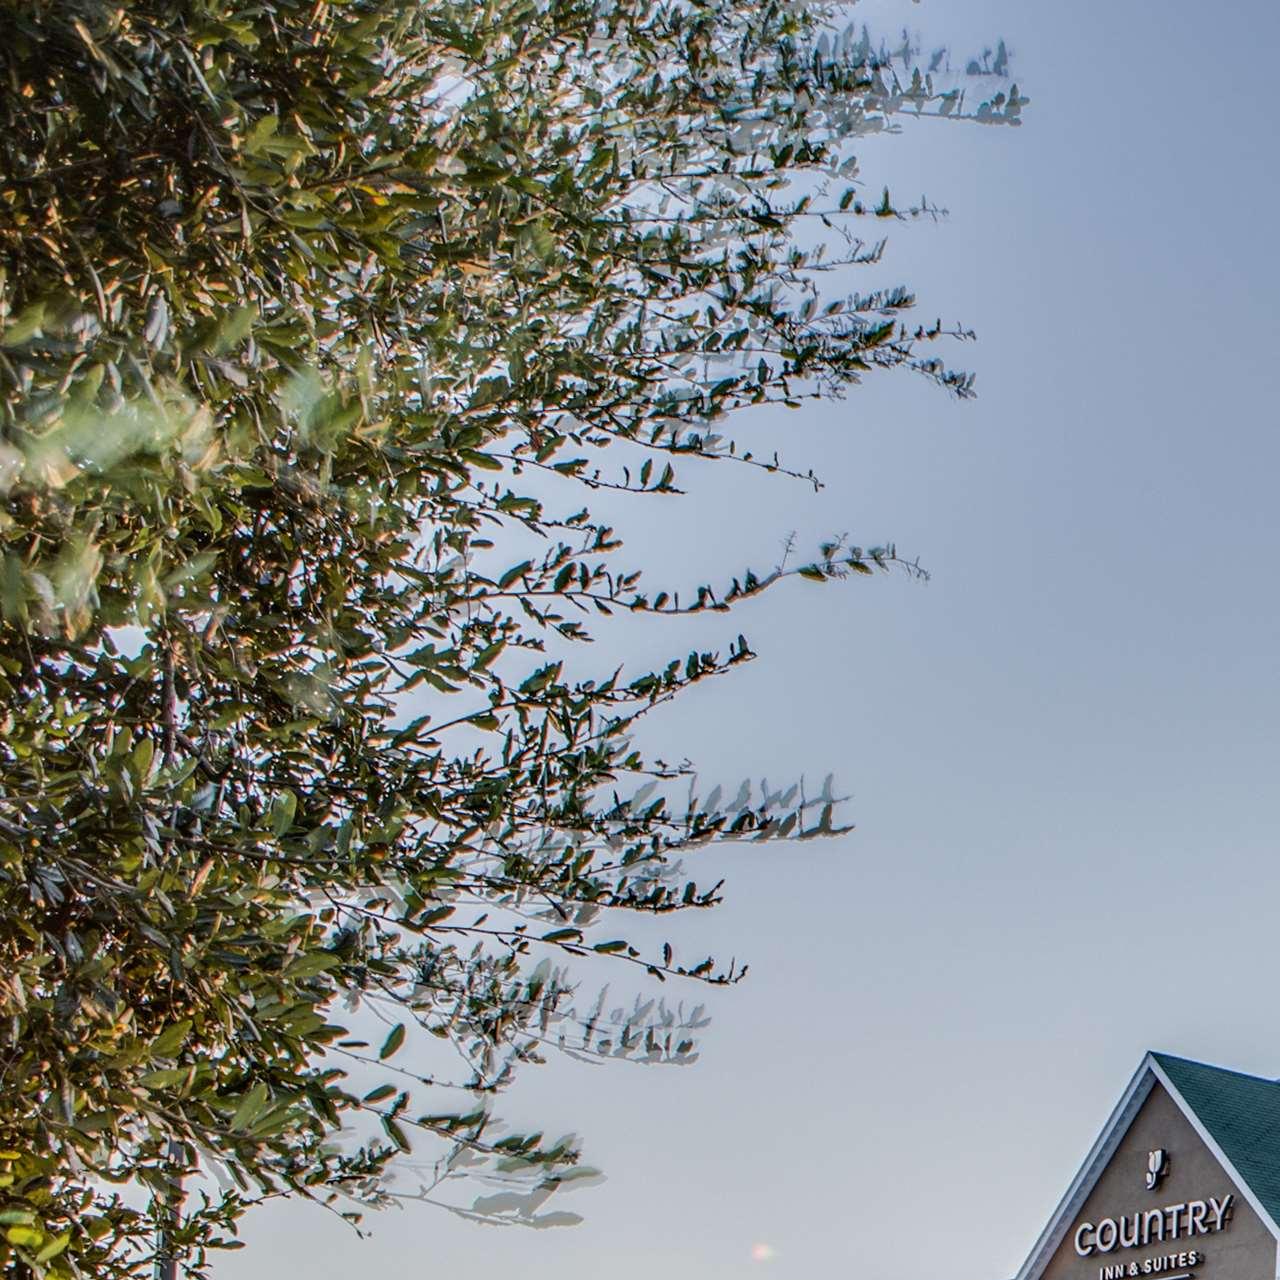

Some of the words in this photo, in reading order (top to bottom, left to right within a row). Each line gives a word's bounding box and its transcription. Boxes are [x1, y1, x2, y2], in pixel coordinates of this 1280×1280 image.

[1074, 1194, 1232, 1257] COUNTRY
[1128, 1261, 1139, 1276] &
[1143, 1250, 1197, 1274] SUITES
